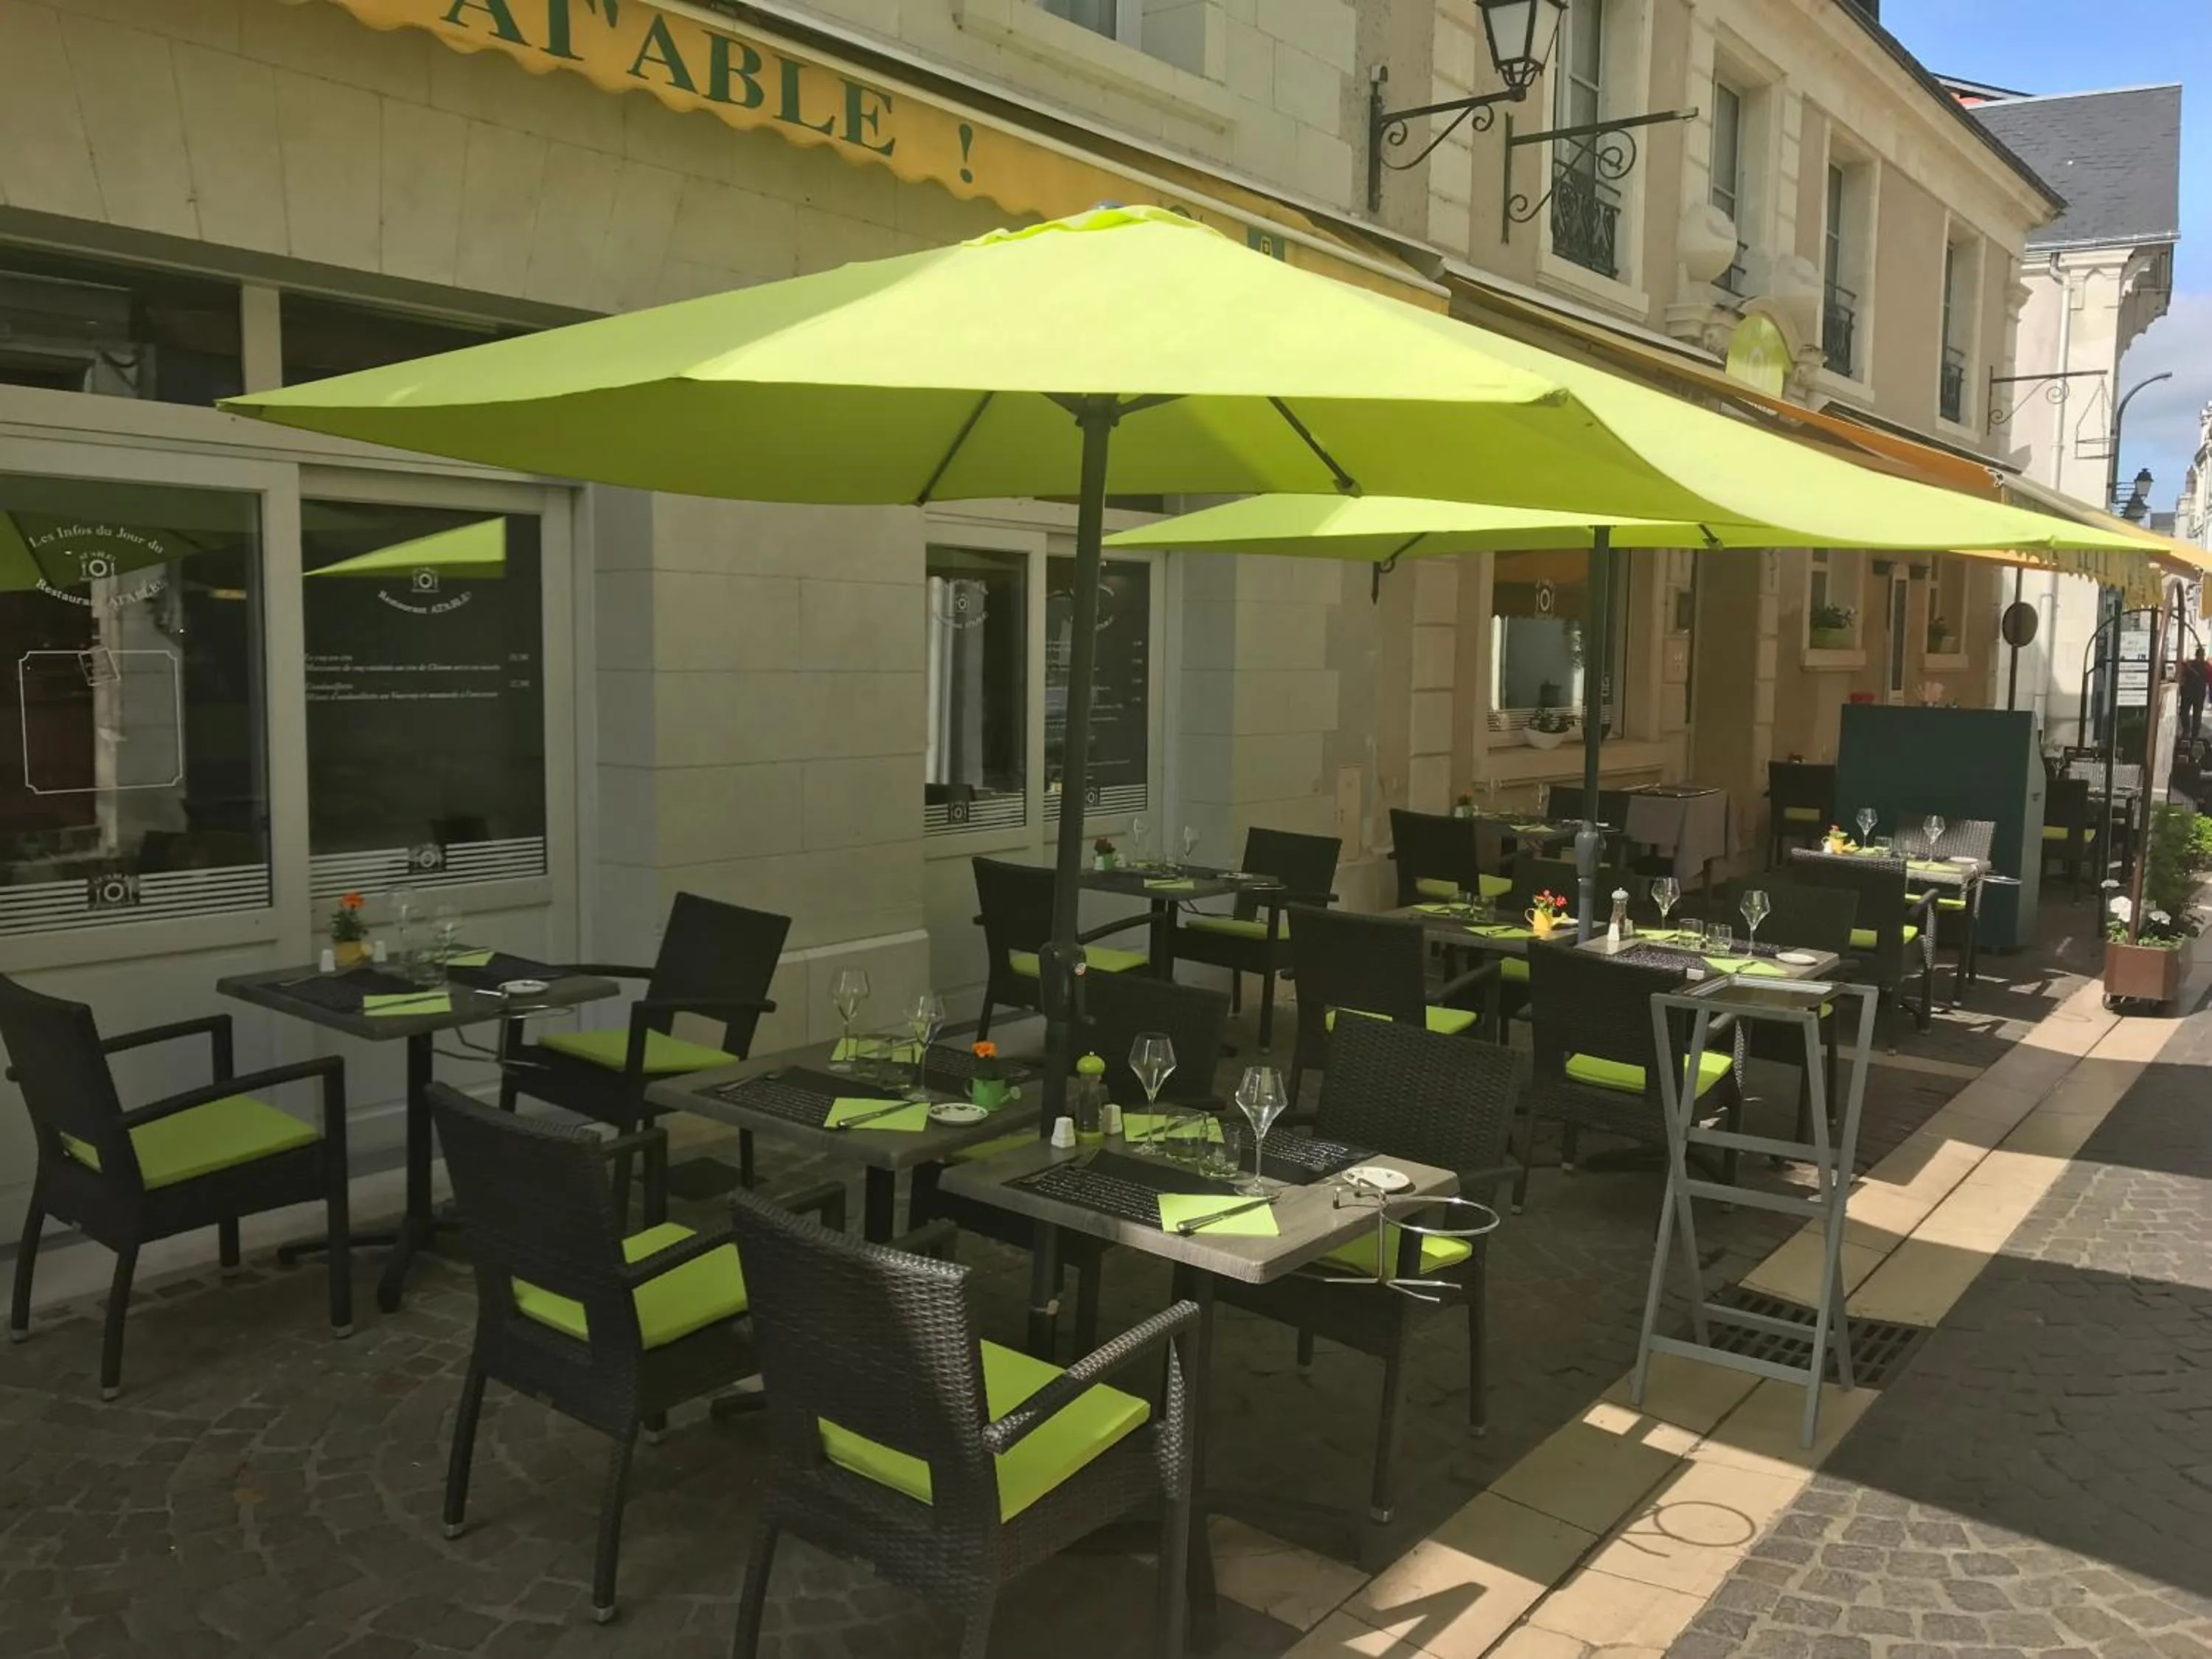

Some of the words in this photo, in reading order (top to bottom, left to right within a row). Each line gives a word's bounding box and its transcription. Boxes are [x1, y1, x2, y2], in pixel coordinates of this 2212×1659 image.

[28, 532, 55, 549] Les
[57, 524, 93, 538] Infos
[96, 524, 112, 536] du
[116, 526, 147, 544] Jour
[147, 538, 164, 554] du
[35, 577, 103, 605] Restaura
